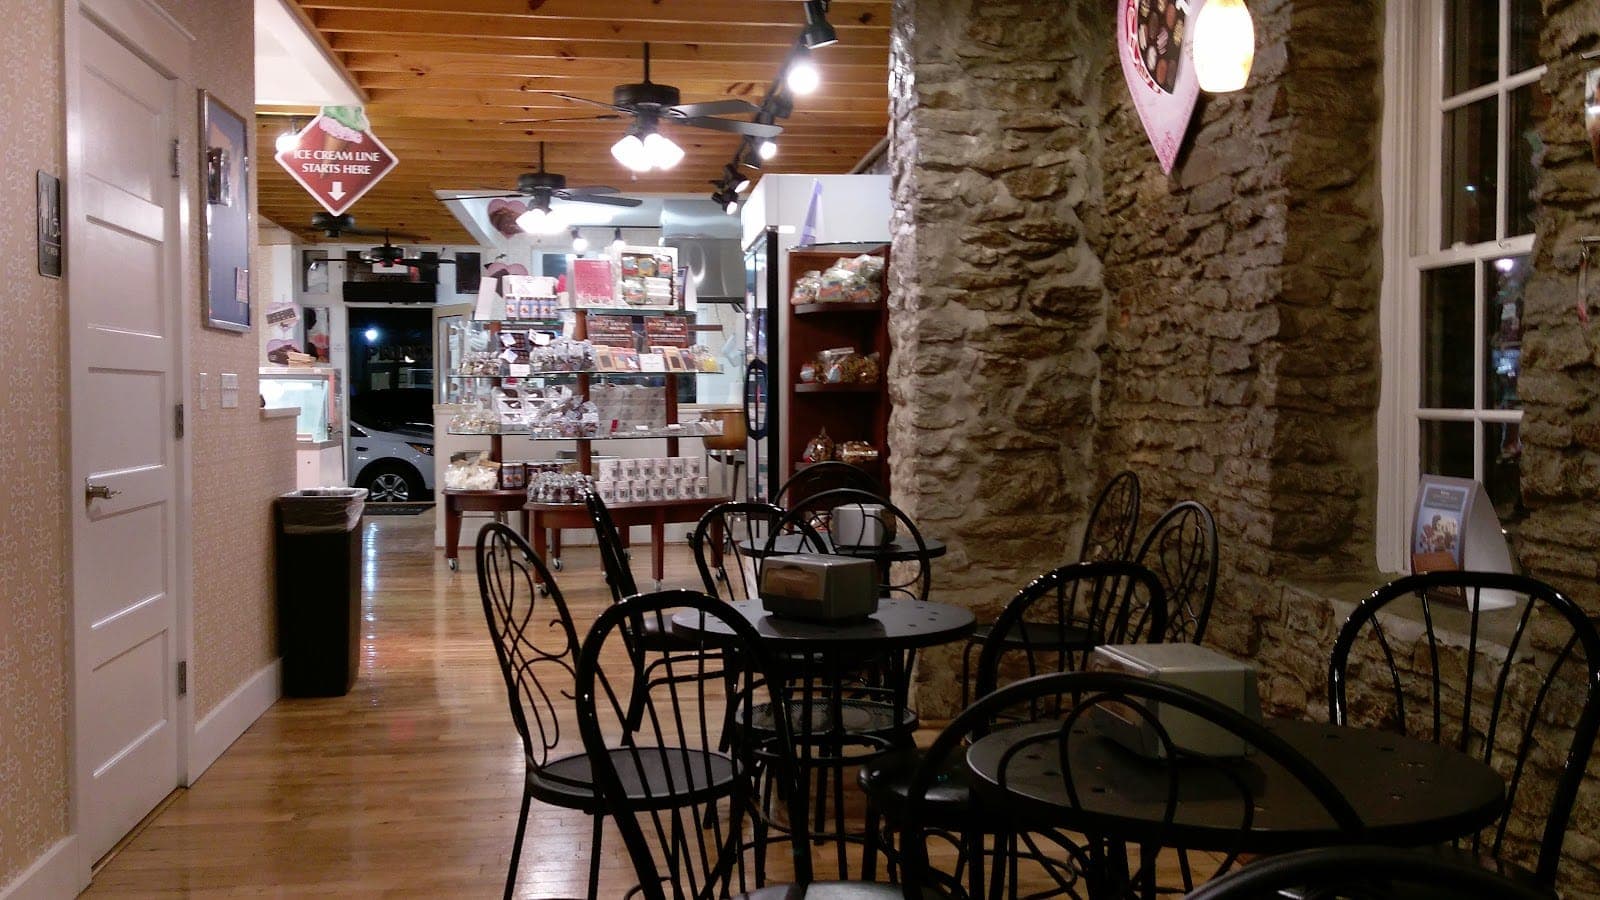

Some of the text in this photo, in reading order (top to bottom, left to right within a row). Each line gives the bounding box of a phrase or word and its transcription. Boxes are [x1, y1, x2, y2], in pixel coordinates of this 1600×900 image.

[294, 150, 380, 162] ICE CREAM LINE
[302, 163, 371, 175] STARTS HERE
